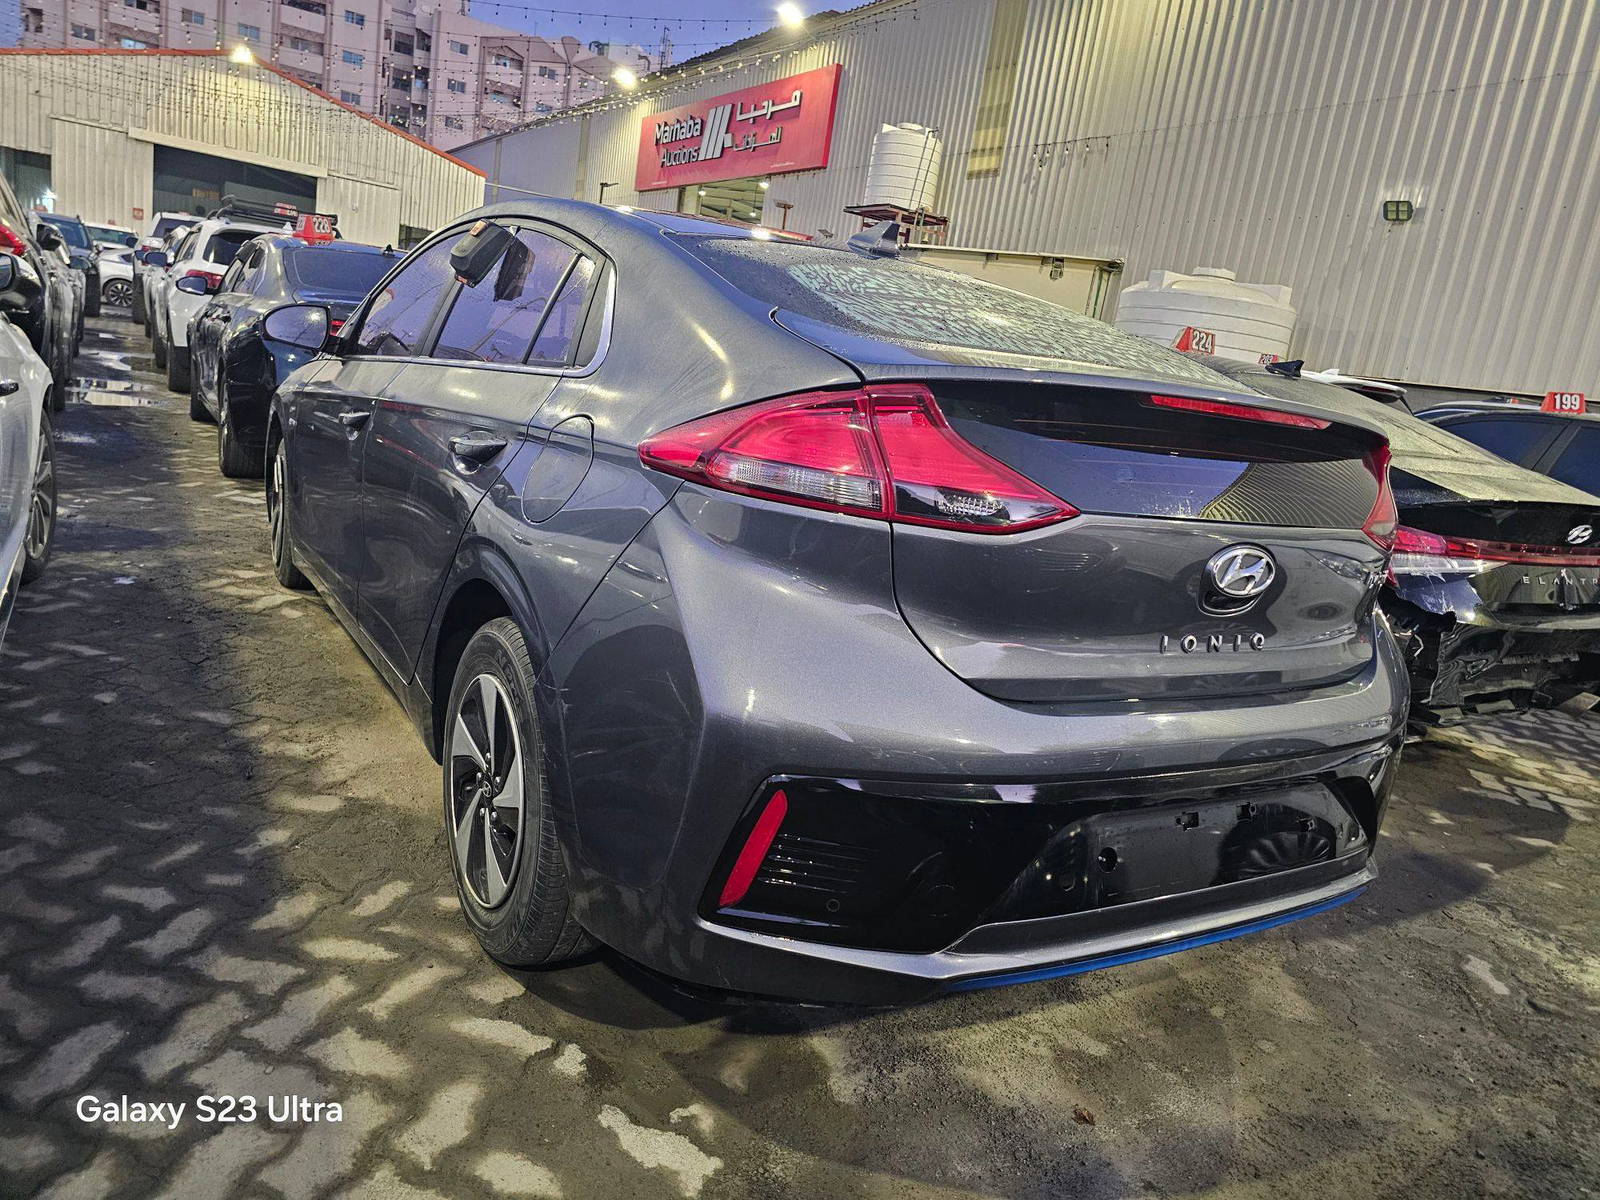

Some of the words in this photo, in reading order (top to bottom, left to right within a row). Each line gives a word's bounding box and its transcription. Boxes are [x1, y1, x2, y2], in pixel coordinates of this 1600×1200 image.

[736, 90, 802, 123] مرحبا
[654, 115, 702, 145] Marhaba
[660, 146, 700, 167] Auctions
[312, 215, 331, 233] 228
[1192, 331, 1212, 353] 224
[1554, 394, 1580, 410] 199
[1160, 632, 1265, 654] IONIQ
